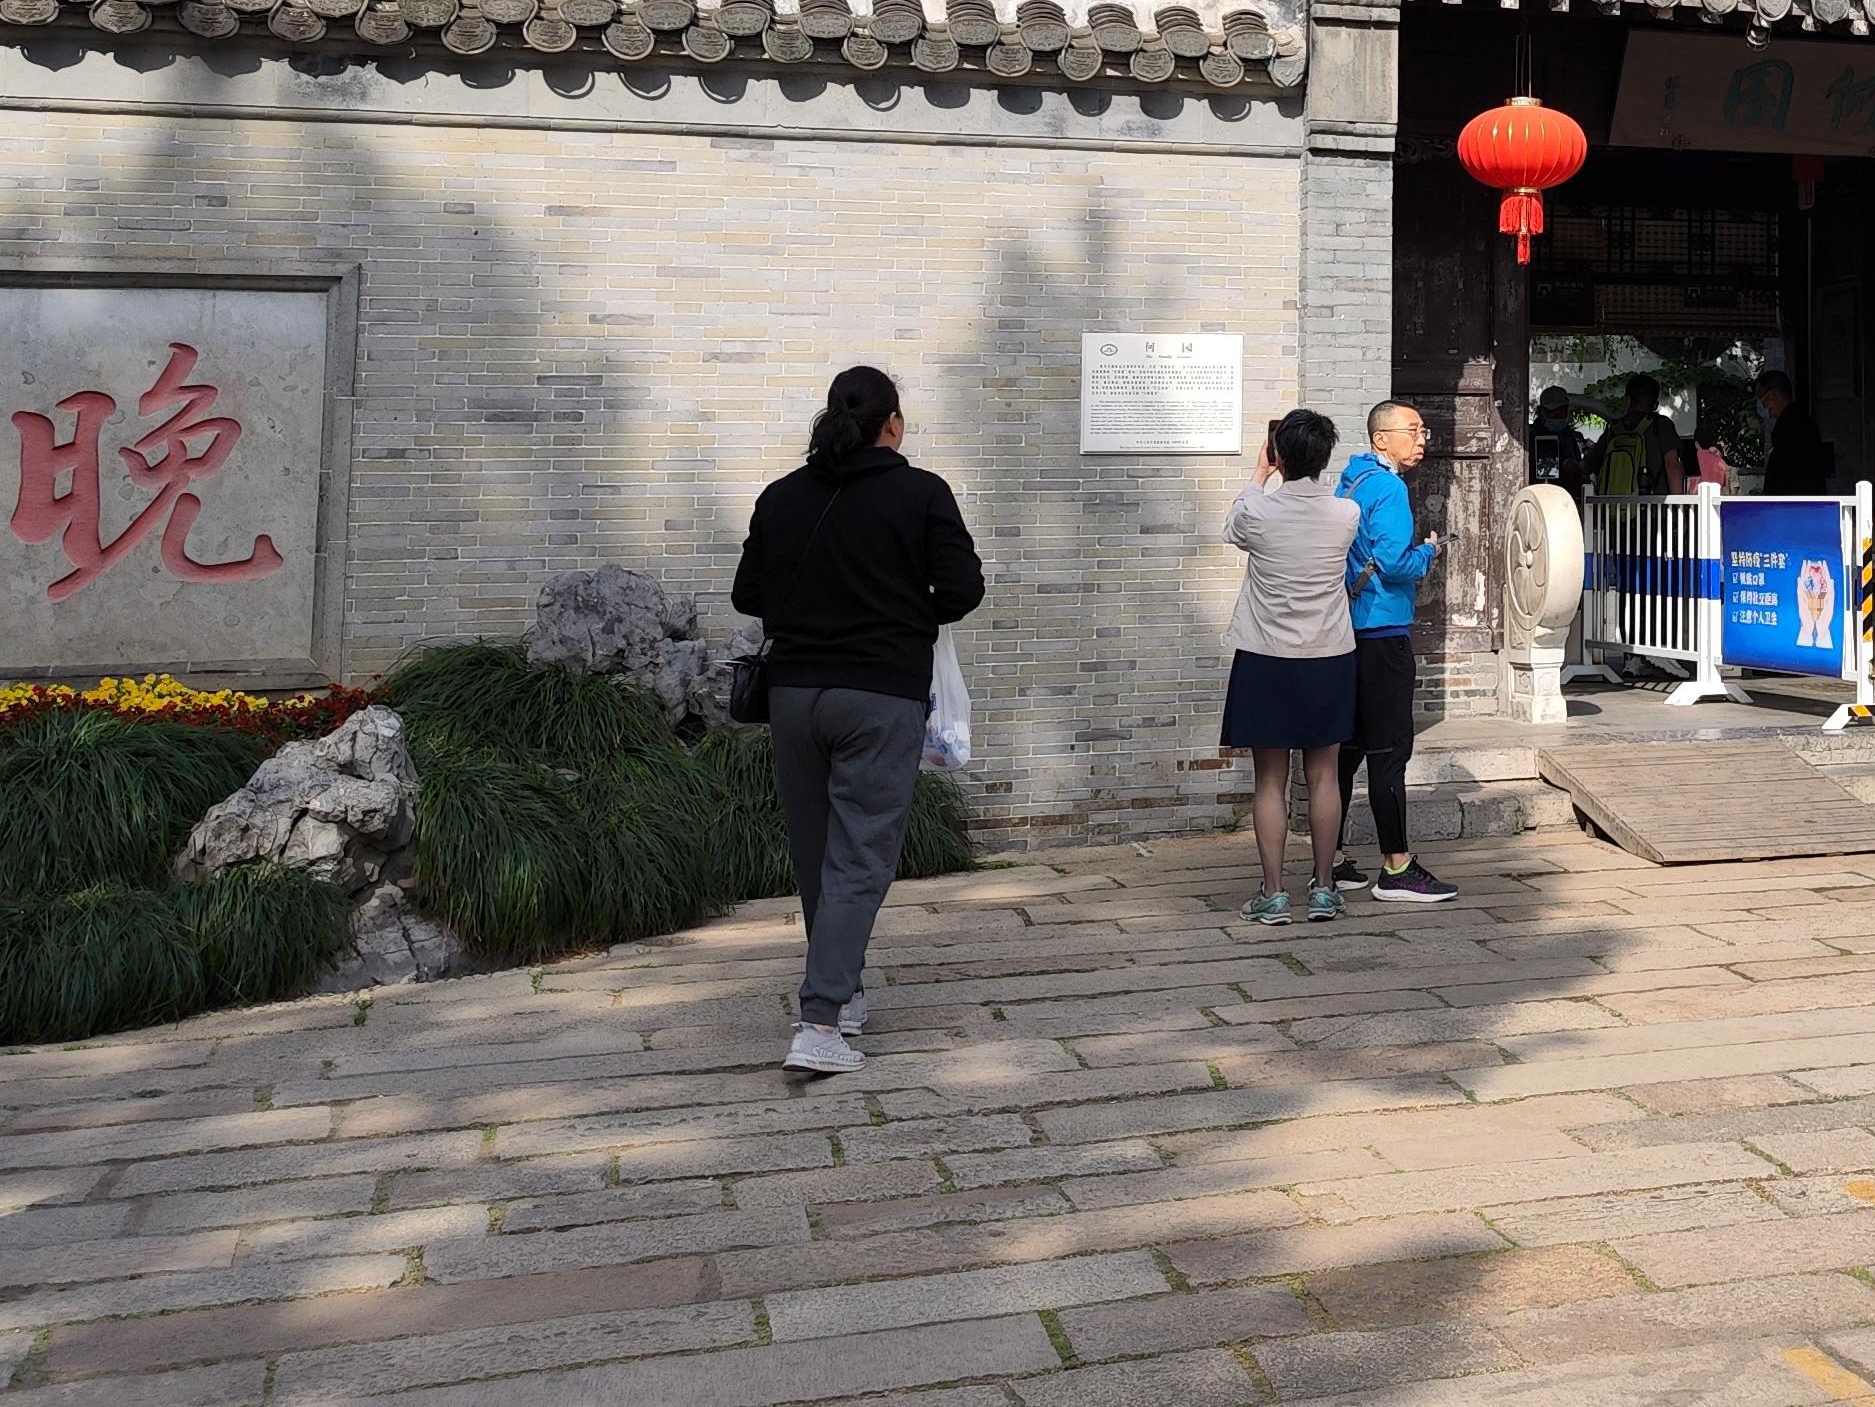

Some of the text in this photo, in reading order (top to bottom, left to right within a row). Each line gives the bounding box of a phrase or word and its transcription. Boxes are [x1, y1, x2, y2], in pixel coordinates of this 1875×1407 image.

[11, 342, 284, 603] 晚
[1740, 610, 1777, 625] 注意个人卫生
